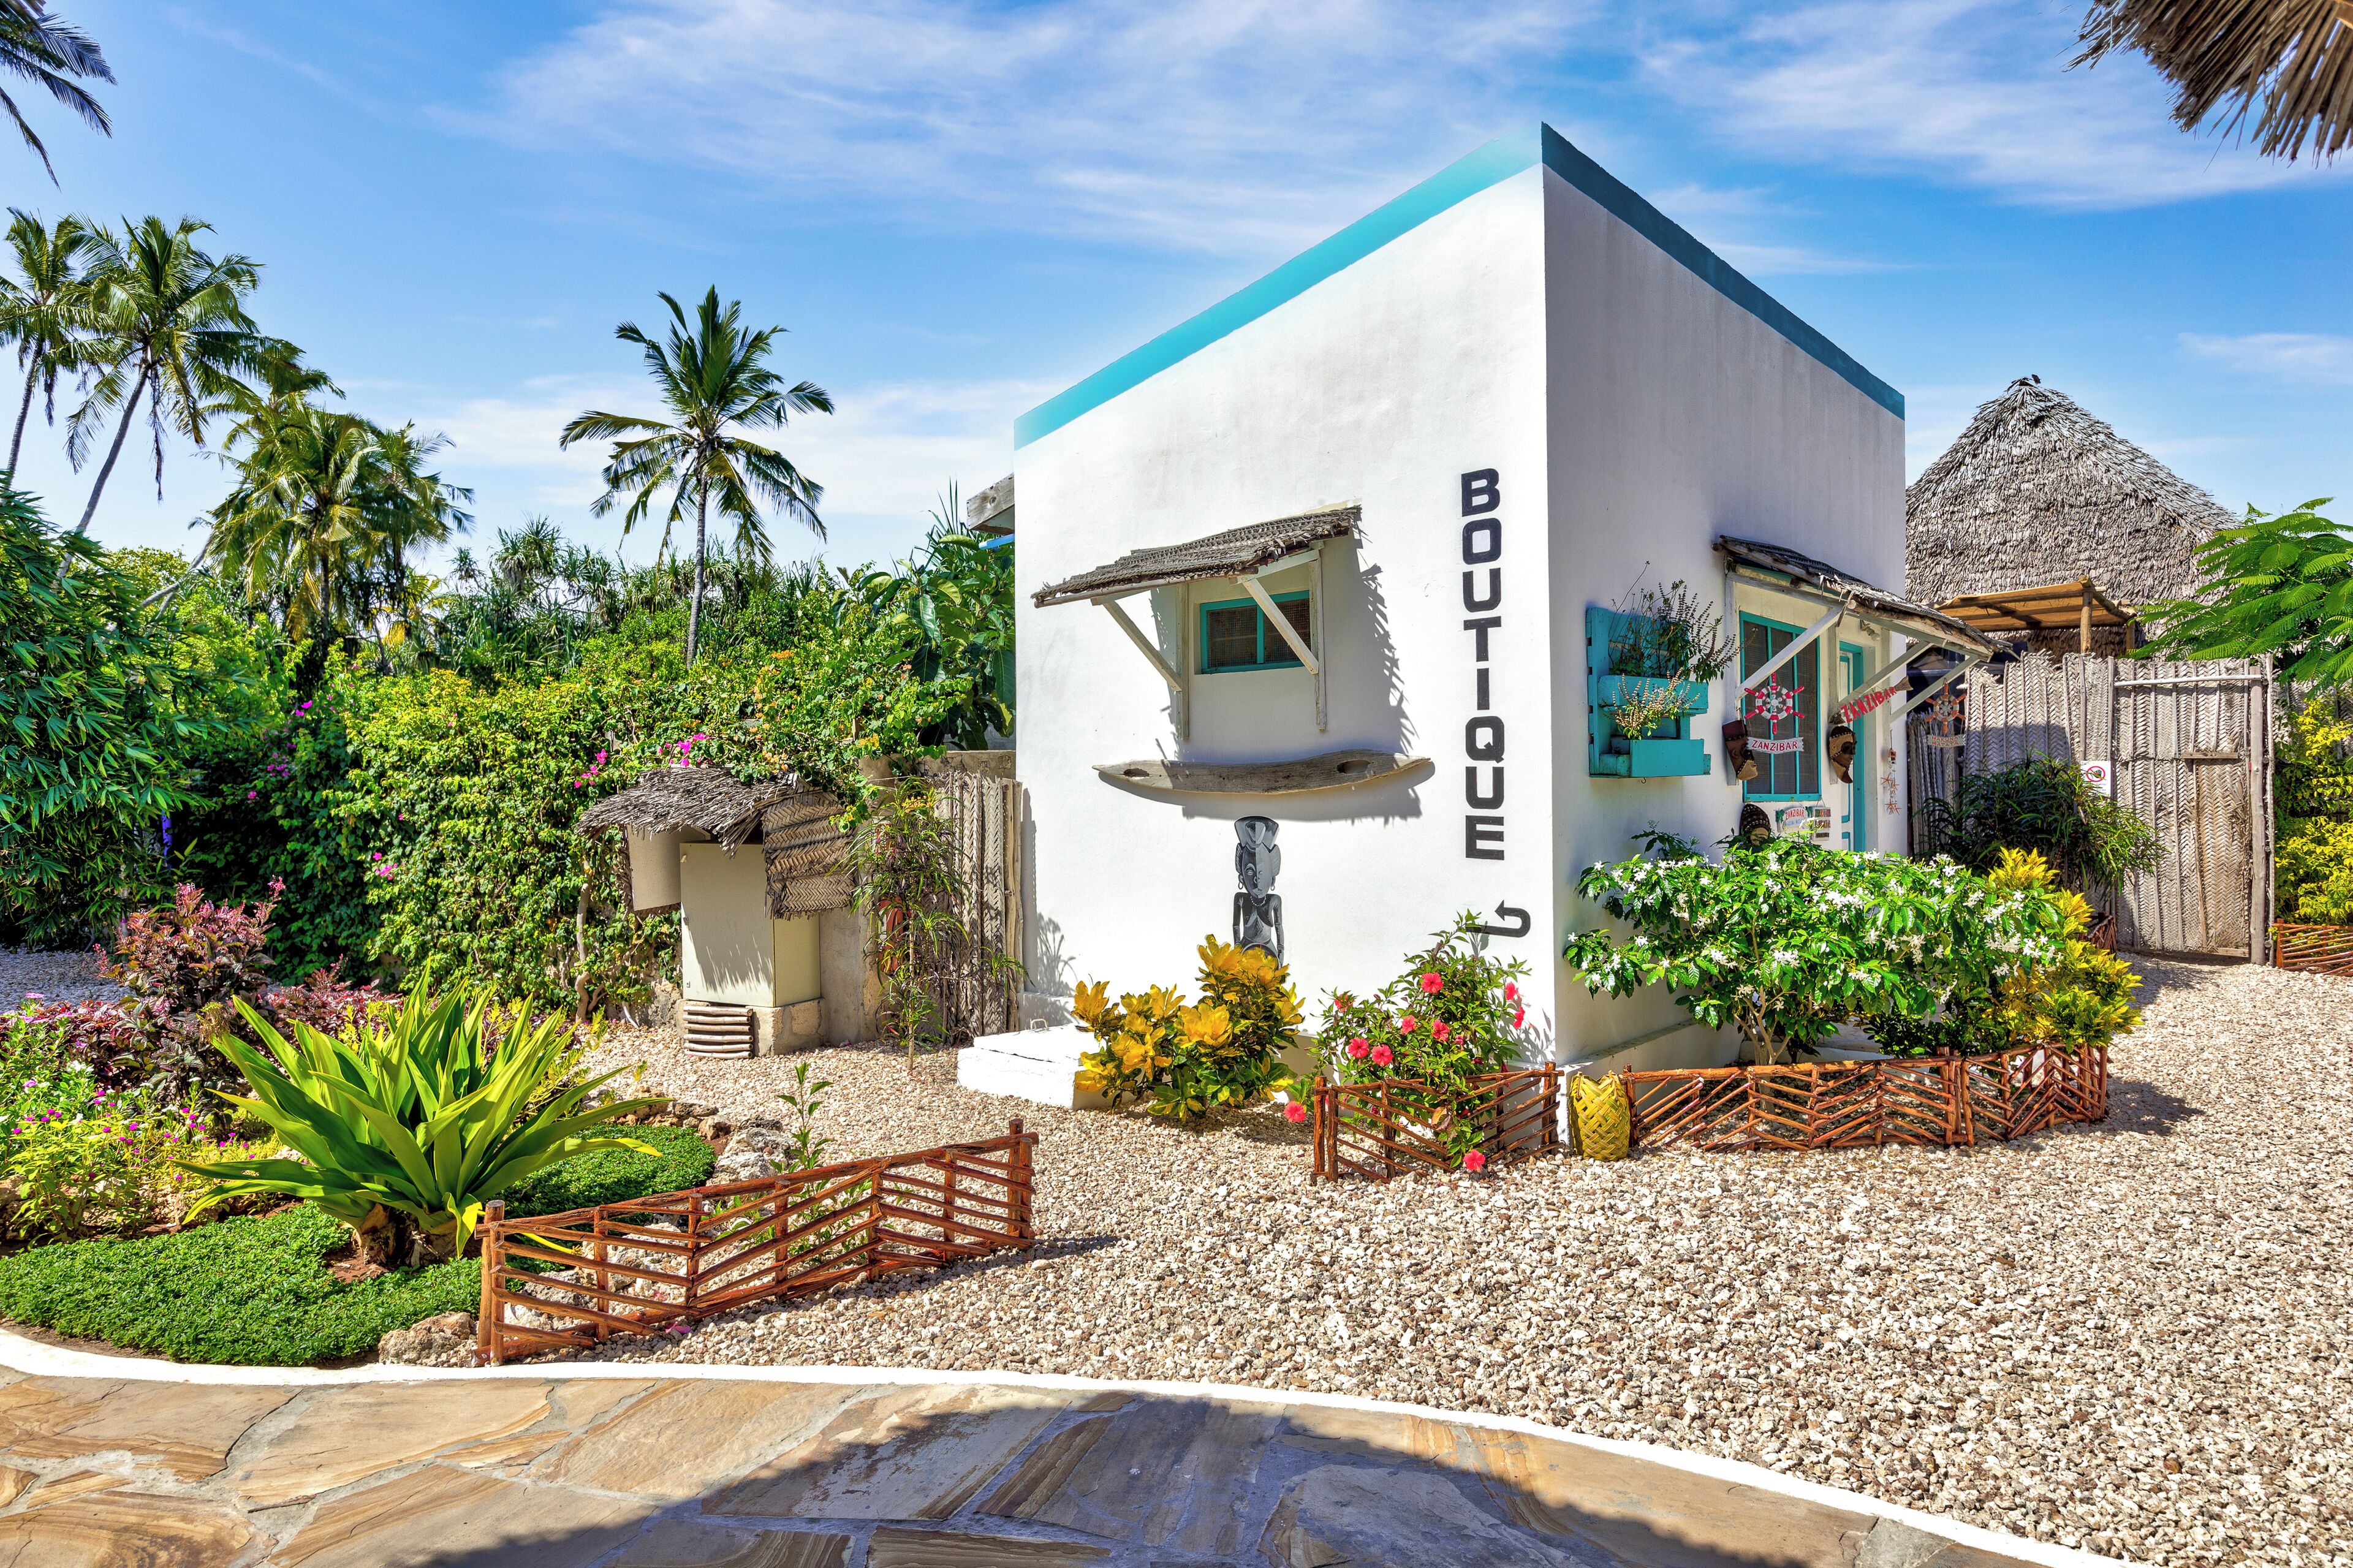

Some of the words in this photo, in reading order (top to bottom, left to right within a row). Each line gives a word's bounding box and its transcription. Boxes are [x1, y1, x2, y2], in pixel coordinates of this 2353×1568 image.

[1461, 468, 1505, 861] BOUTIQUE
[1840, 686, 1897, 724] ZANZIBAR
[1752, 740, 1798, 751] ZANZIBAR
[1784, 809, 1805, 820] ZANZIBAR
